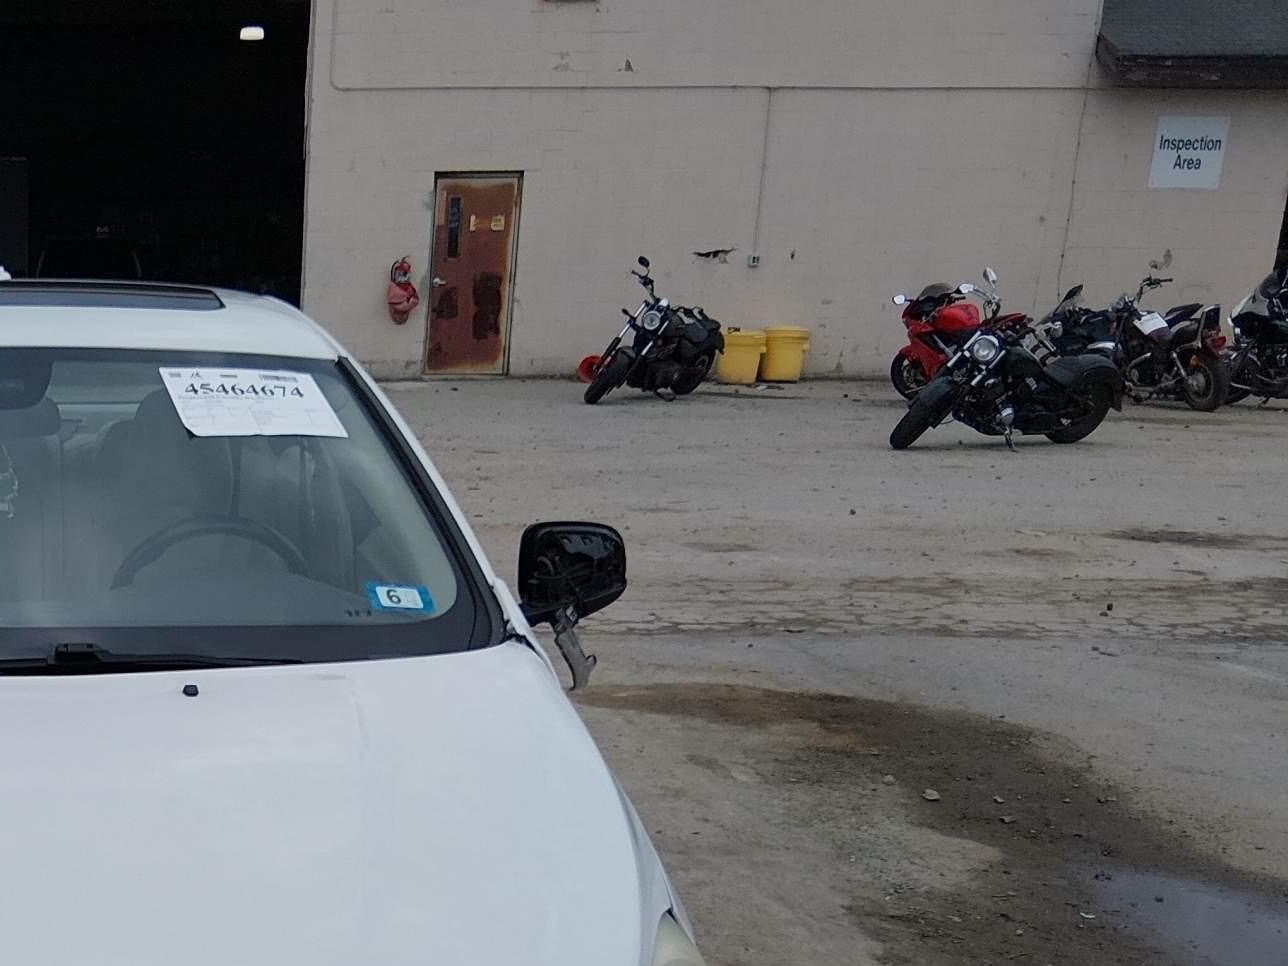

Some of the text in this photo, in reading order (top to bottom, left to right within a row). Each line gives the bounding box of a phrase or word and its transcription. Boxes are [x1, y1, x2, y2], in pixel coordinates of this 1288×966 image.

[1159, 135, 1222, 153] Inspection
[1172, 154, 1202, 170] Area
[184, 383, 305, 398] 45464674
[386, 589, 402, 605] 6
